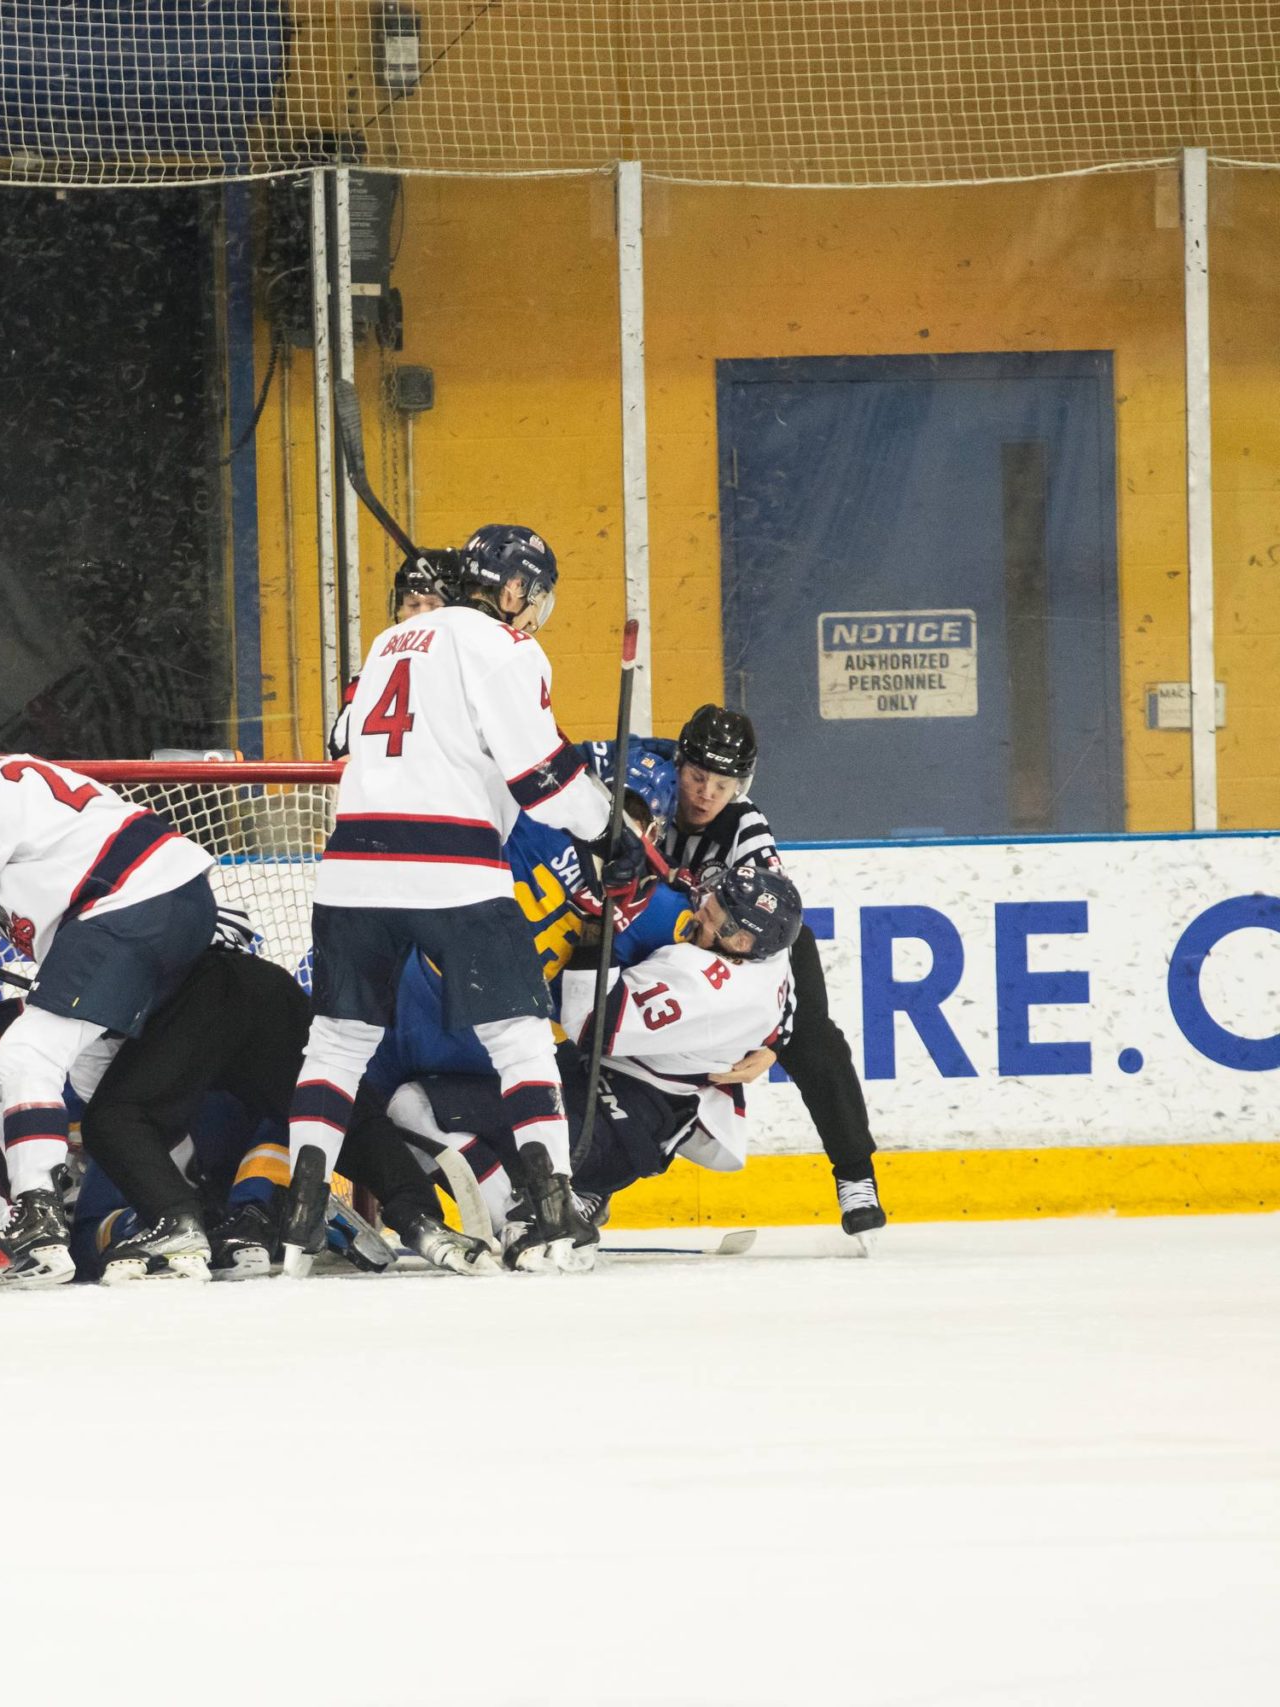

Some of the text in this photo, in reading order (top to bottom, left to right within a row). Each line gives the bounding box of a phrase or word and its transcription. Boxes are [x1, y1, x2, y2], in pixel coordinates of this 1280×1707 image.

[521, 559, 542, 574] CCM
[380, 629, 435, 657] BORIA
[832, 621, 962, 645] NOTICE
[844, 652, 949, 671] AUTHORIZED
[848, 673, 947, 691] PERSONNEL
[361, 657, 415, 757] 4
[877, 694, 918, 711] ONLY
[706, 751, 735, 764] CCM
[0, 753, 103, 813] 2
[740, 917, 764, 934] CCM
[701, 956, 732, 990] B
[631, 981, 682, 1031] 13
